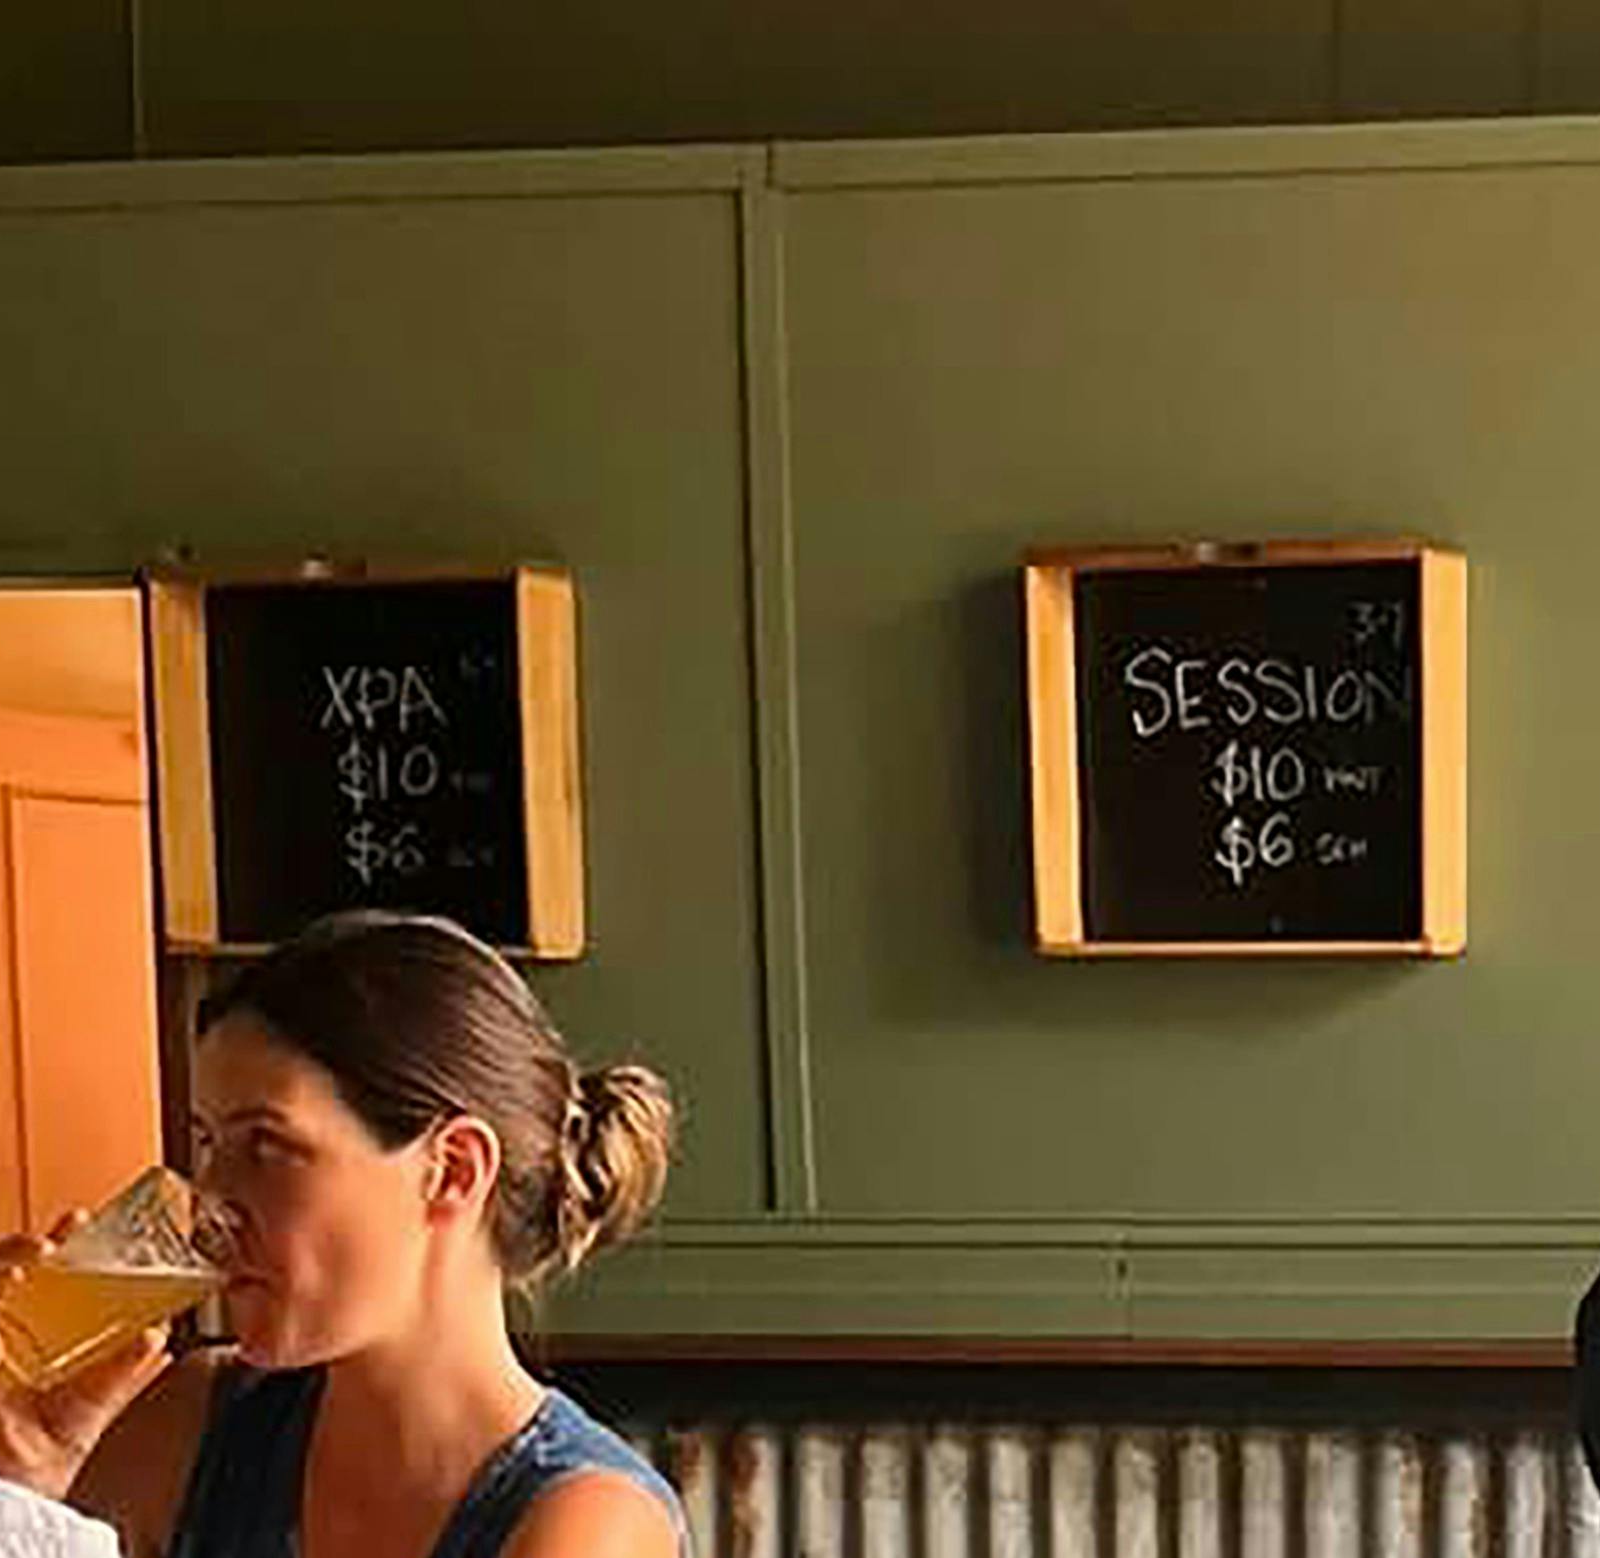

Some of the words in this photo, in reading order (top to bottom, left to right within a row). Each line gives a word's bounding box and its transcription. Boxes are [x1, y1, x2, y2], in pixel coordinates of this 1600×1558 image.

[319, 664, 449, 734] XPA
[1124, 646, 1411, 736] SESSION
[337, 730, 441, 815] $10
[1212, 740, 1306, 807] $10
[1215, 816, 1295, 886] $6
